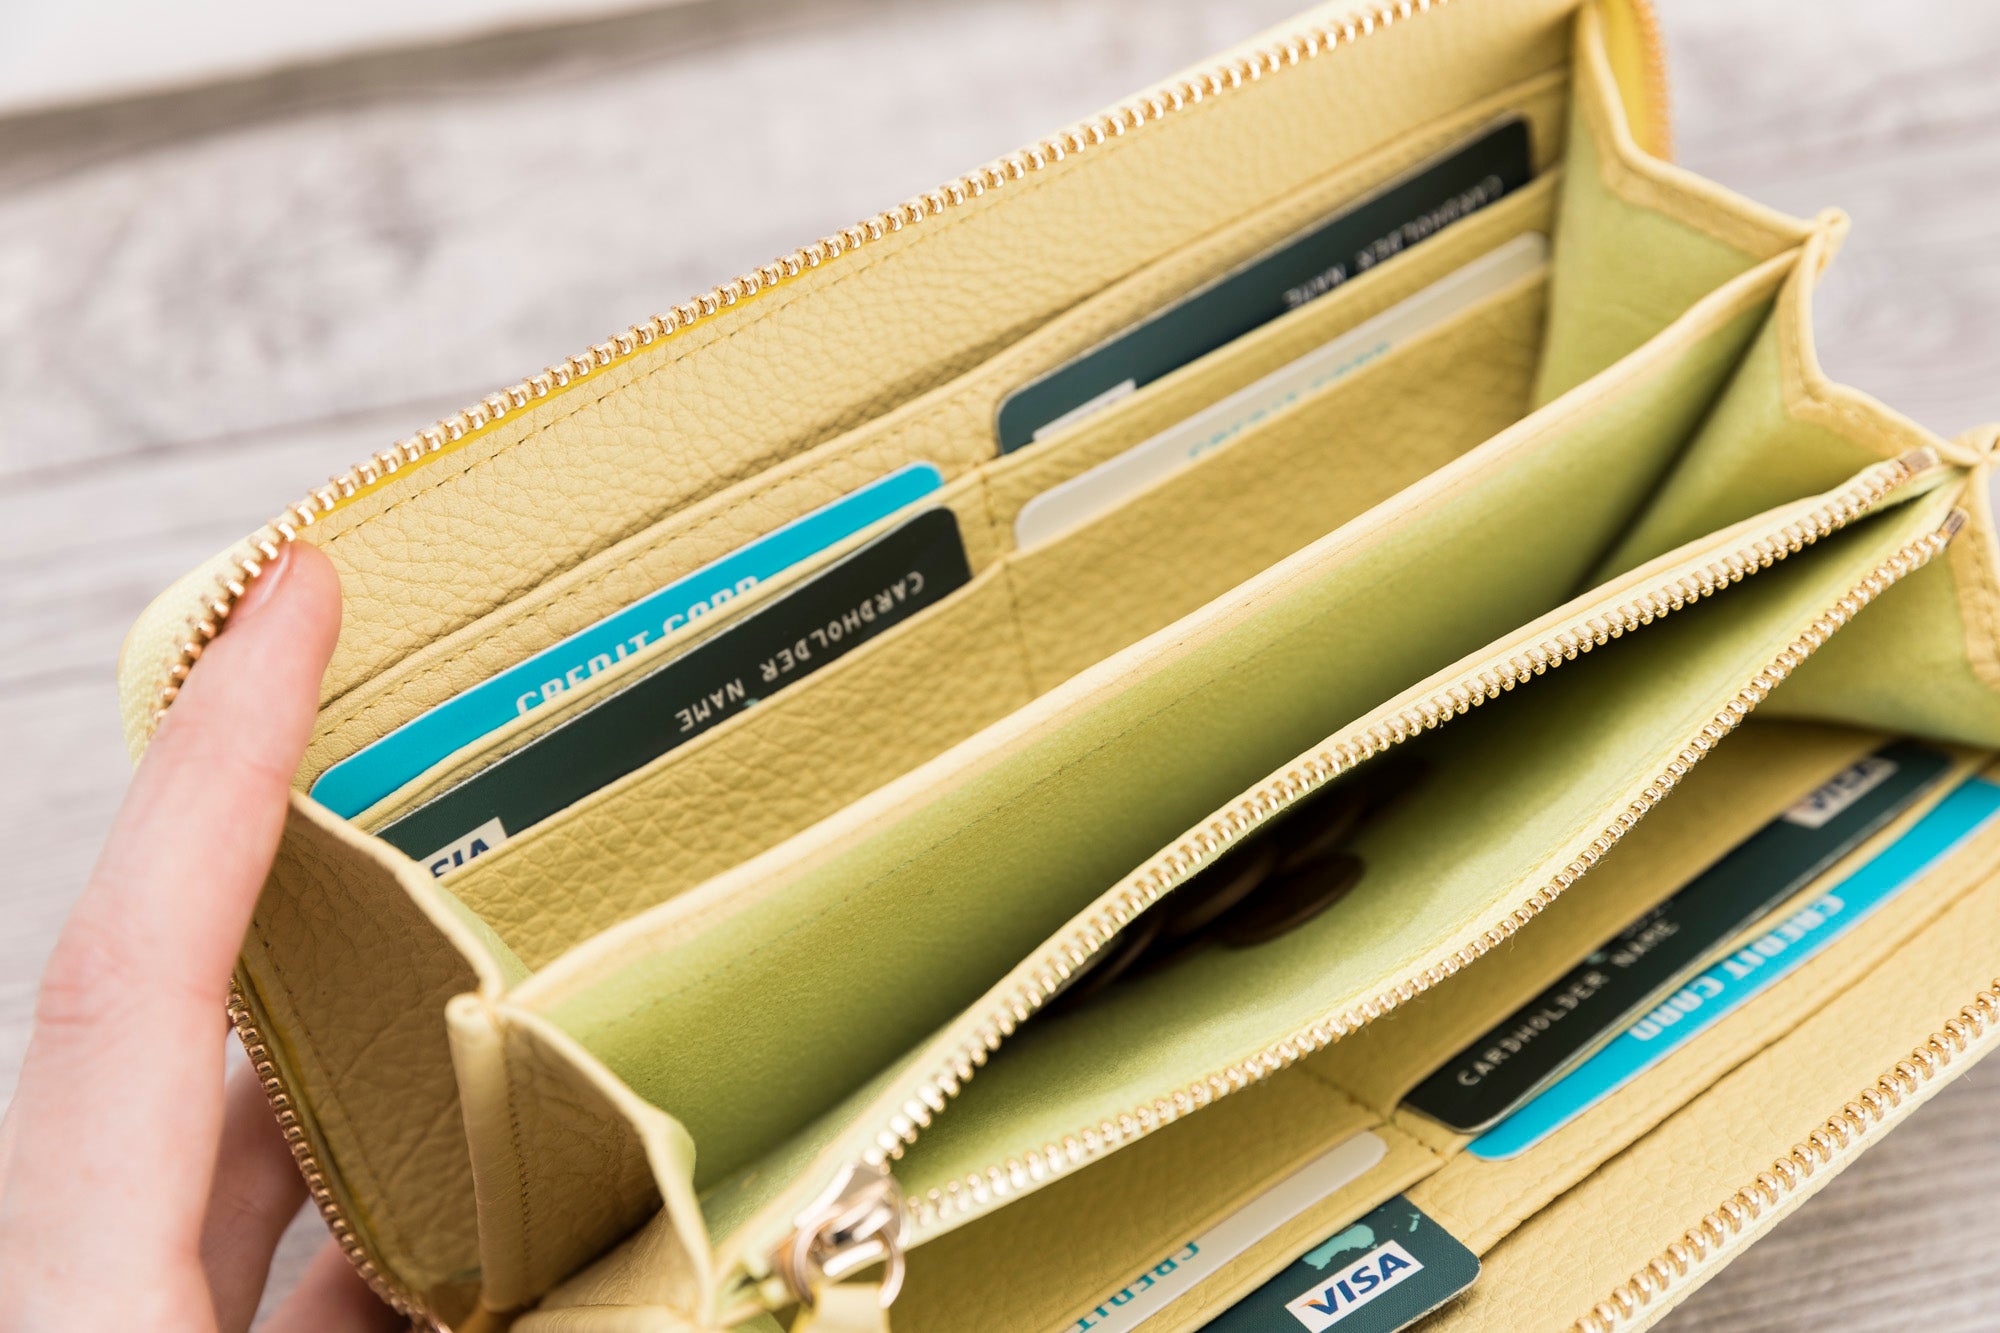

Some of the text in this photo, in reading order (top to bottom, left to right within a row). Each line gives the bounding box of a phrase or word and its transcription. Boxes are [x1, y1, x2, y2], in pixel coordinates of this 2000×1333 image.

[674, 570, 925, 733] CARDHOLDER NAME
[1721, 893, 1845, 981] CREDIT
[1456, 971, 1610, 1086] CARDHOLDER
[1611, 918, 1681, 968] NAME
[1627, 975, 1725, 1041] CARD
[1300, 1252, 1412, 1316] VISA
